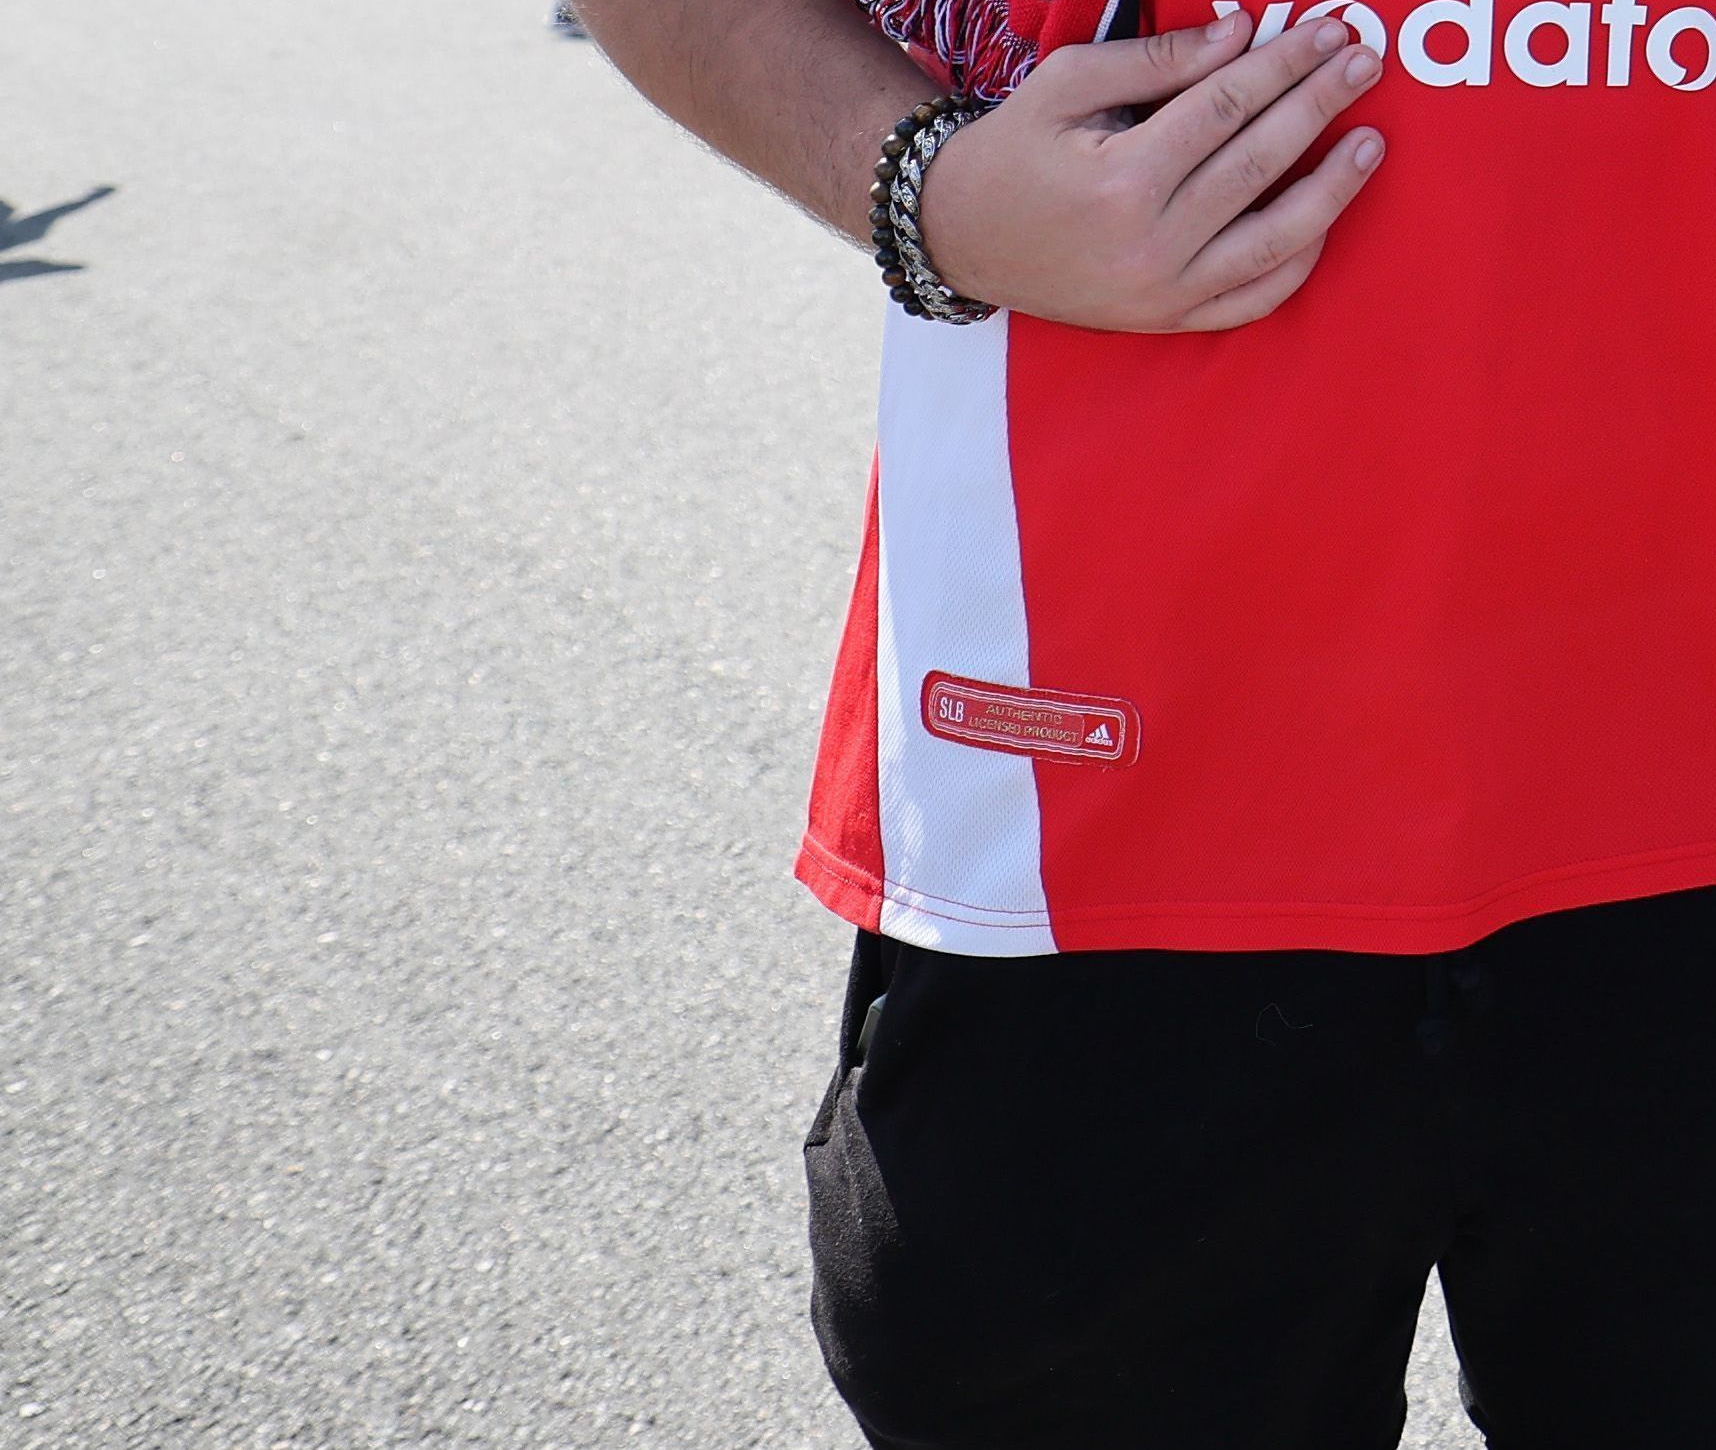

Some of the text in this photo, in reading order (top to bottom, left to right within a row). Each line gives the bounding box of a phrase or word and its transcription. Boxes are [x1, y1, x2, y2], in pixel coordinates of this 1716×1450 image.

[939, 696, 964, 722] SLB
[985, 703, 1063, 725] AUTHENTIC
[968, 716, 1081, 743] LICENSED PRODUCT
